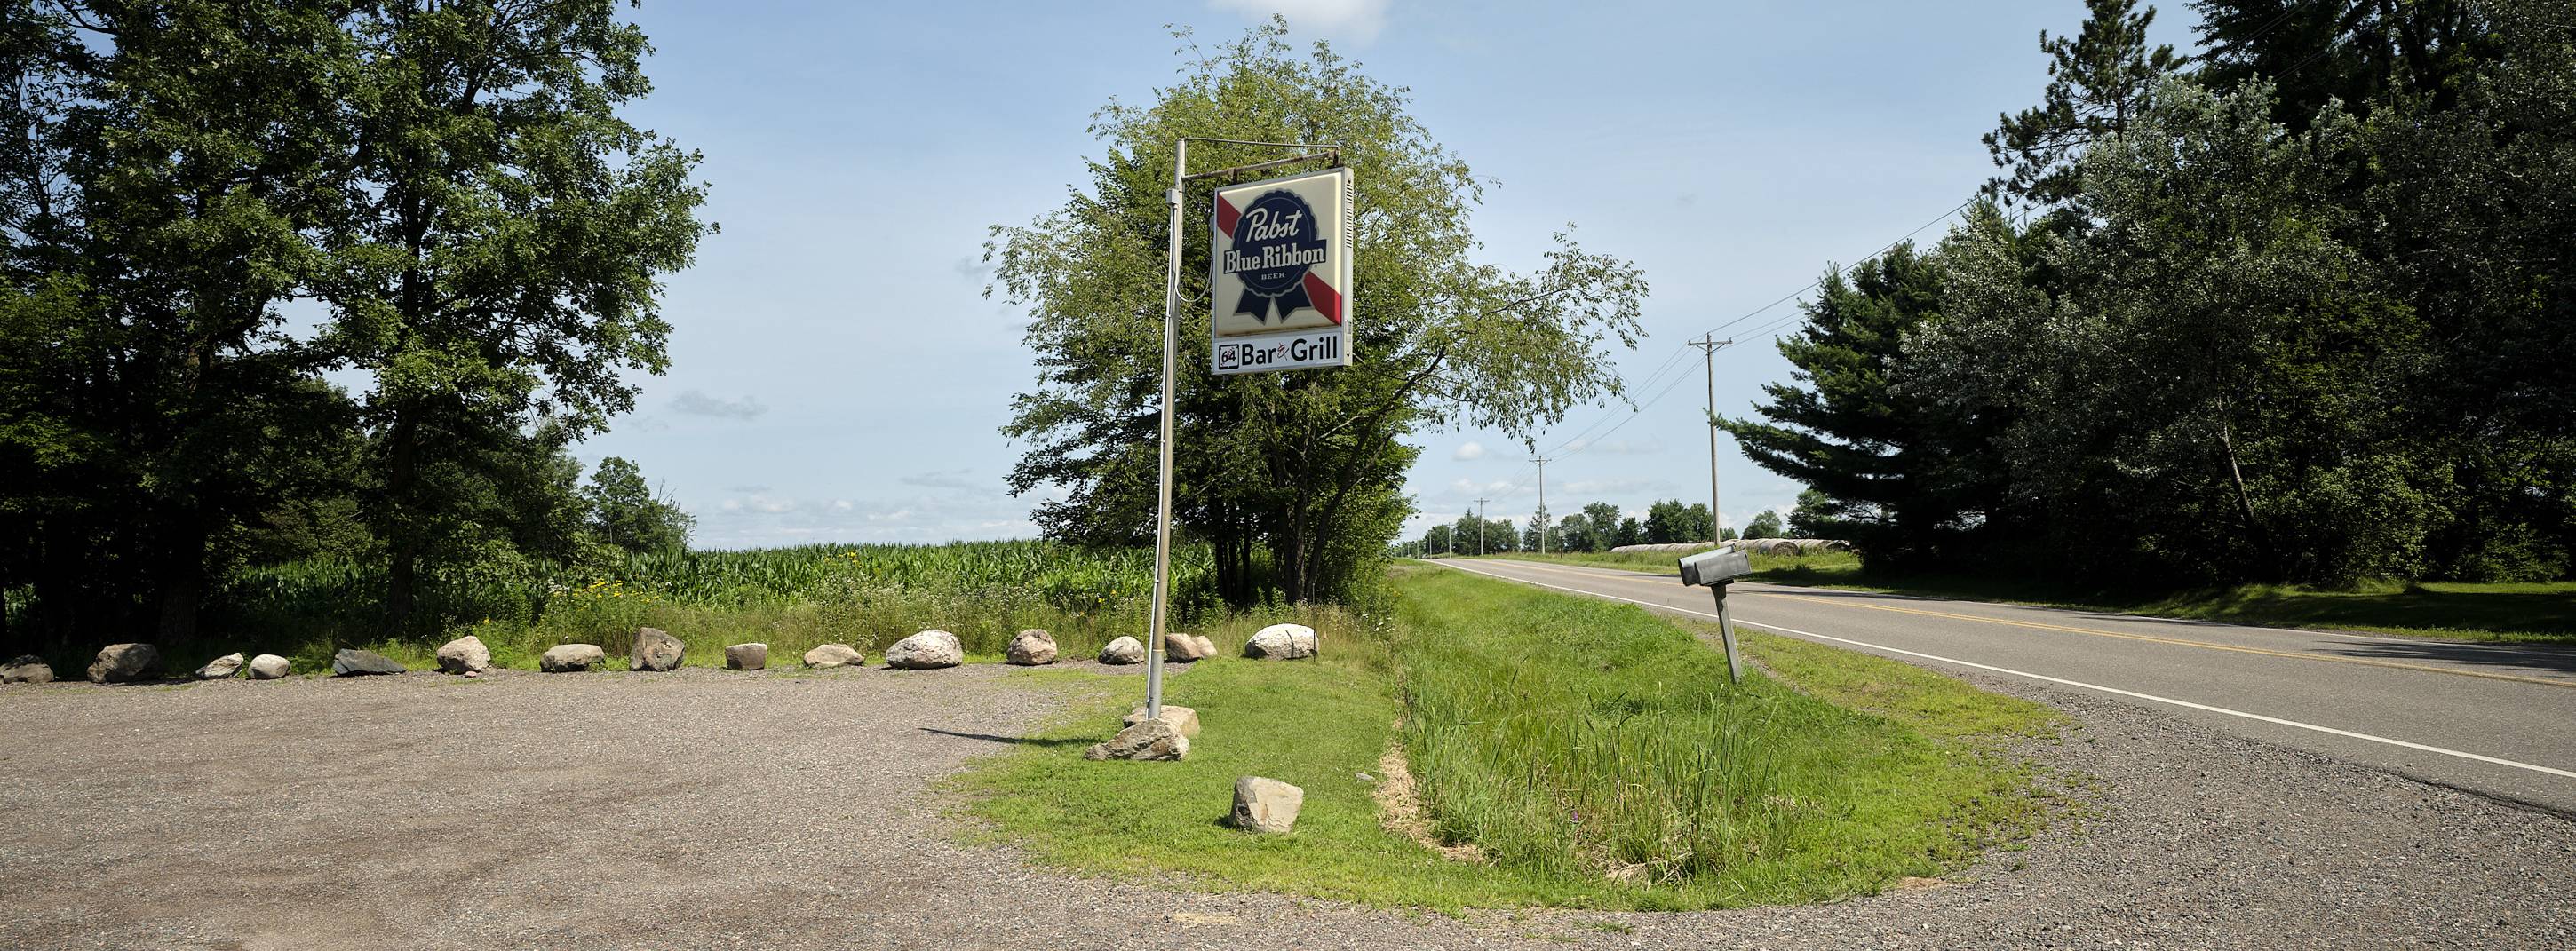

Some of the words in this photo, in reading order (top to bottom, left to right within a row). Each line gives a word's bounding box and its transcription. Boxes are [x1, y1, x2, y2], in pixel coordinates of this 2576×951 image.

[1246, 207, 1303, 242] Pabst
[1225, 250, 1260, 273] Blue
[1262, 242, 1325, 269] Ribbon
[1261, 272, 1285, 281] BEER
[1221, 349, 1236, 363] 64
[1242, 343, 1277, 366] Bar
[1291, 336, 1338, 361] Grill
